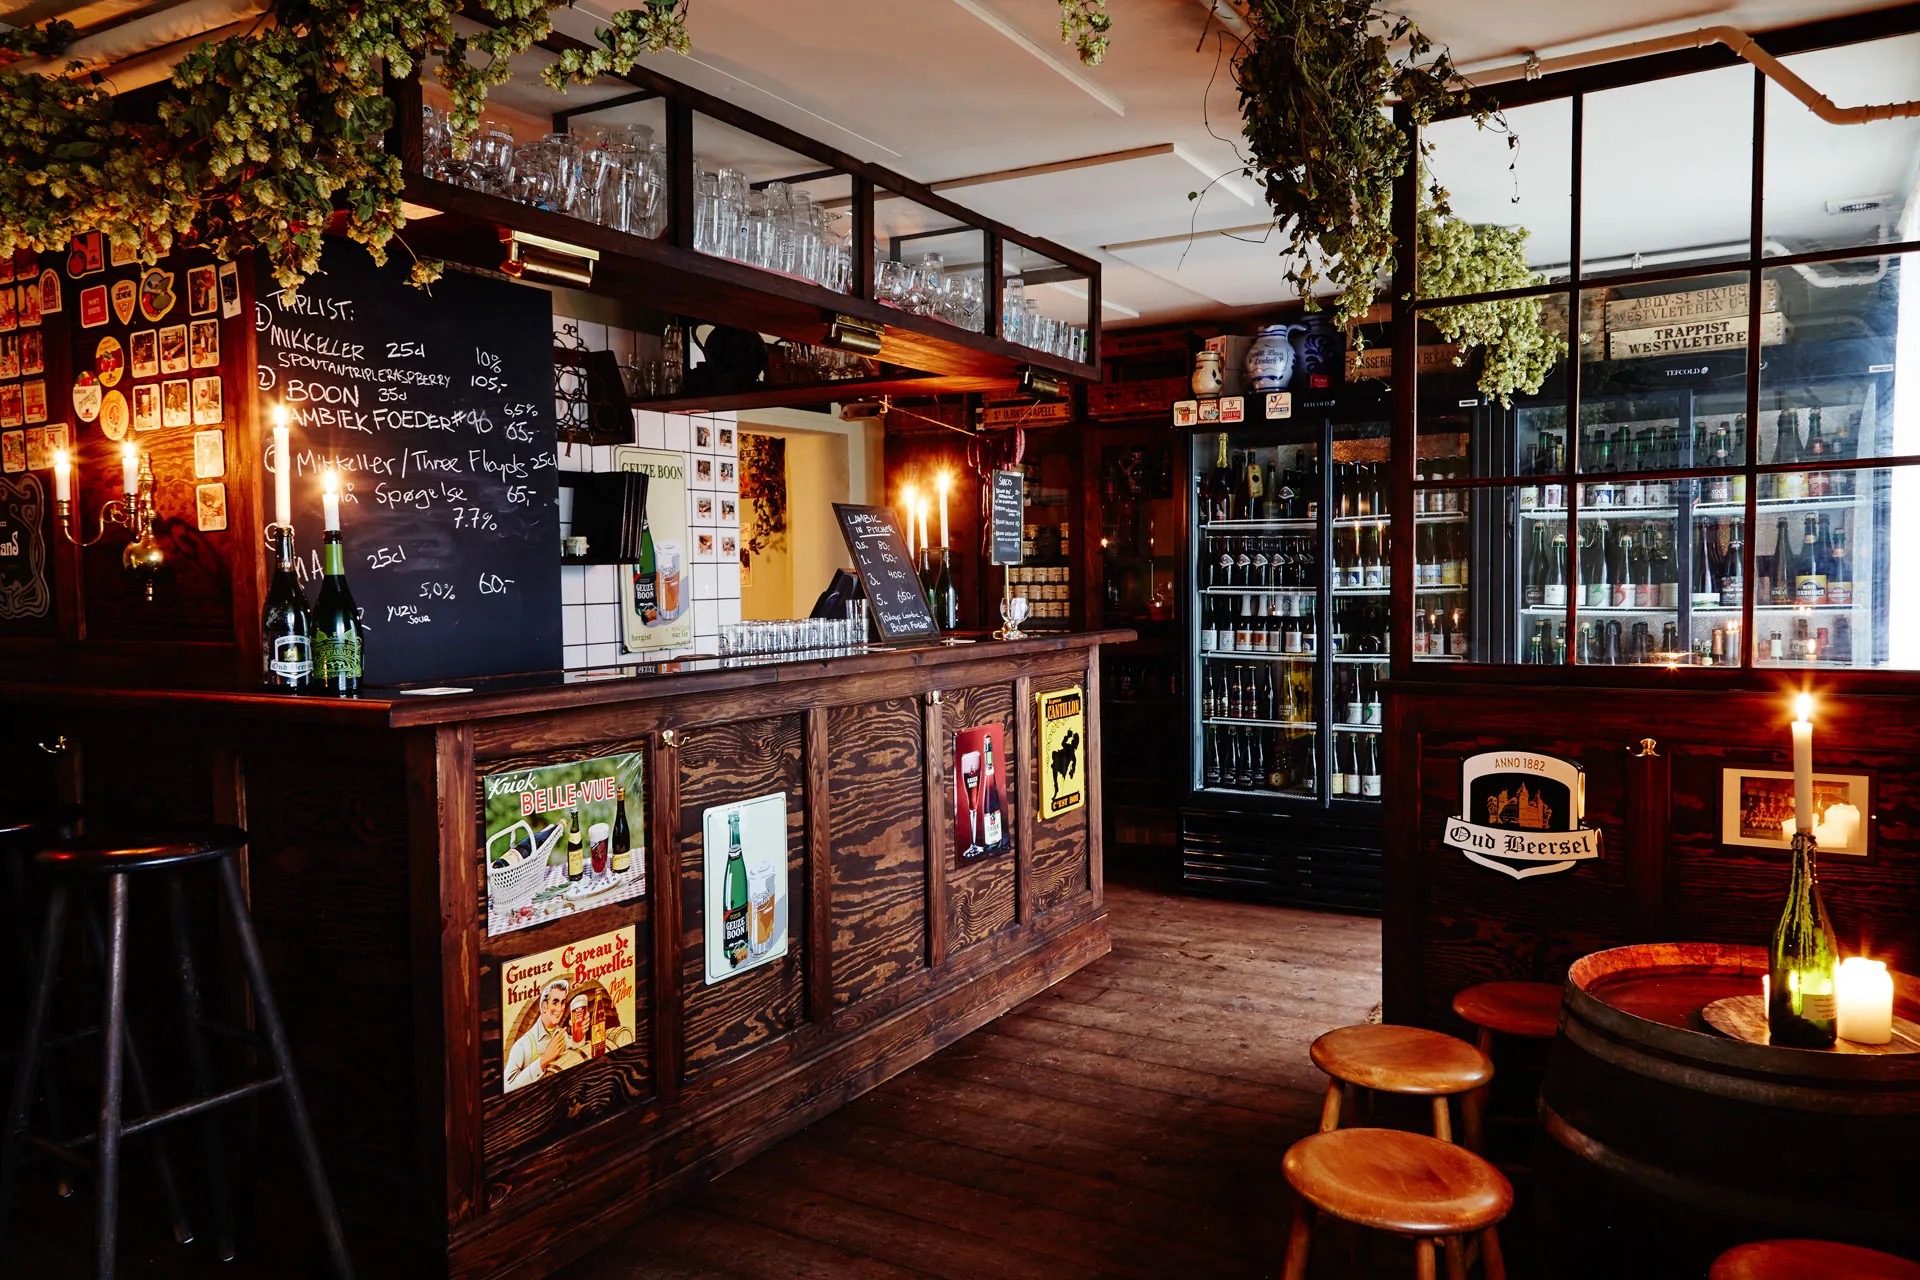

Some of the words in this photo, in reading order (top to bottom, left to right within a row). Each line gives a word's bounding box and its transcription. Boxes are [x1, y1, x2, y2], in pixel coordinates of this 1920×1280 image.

[1697, 285, 1746, 301] SIXTUS
[1654, 321, 1730, 339] TRAPPIST
[271, 324, 364, 361] MIKKELLER
[476, 347, 502, 373] 10%
[1664, 368, 1700, 376] TEFCOLD
[285, 379, 359, 408] BOON
[469, 449, 529, 483] Floyds
[658, 464, 683, 480] BOON
[375, 482, 467, 509] Spøgelse
[453, 508, 498, 531] 7.7%
[367, 545, 406, 569] 25cl
[419, 582, 456, 599] 5,0%
[635, 583, 655, 592] GEUZE
[637, 591, 655, 599] BOON
[1047, 699, 1080, 719] CANTILLON
[1495, 758, 1520, 769] ANNO
[1523, 758, 1546, 771] 1882
[488, 772, 538, 800] Kriek
[1450, 826, 1496, 849] Oud
[1503, 835, 1592, 855] Beersel
[725, 916, 746, 931] GEUZE
[726, 926, 745, 940] BOON
[505, 960, 554, 985] Gueuze
[561, 943, 612, 969] Caveau
[615, 934, 629, 949] de
[507, 980, 541, 1006] Kriek
[572, 951, 634, 990] Bruxelles
